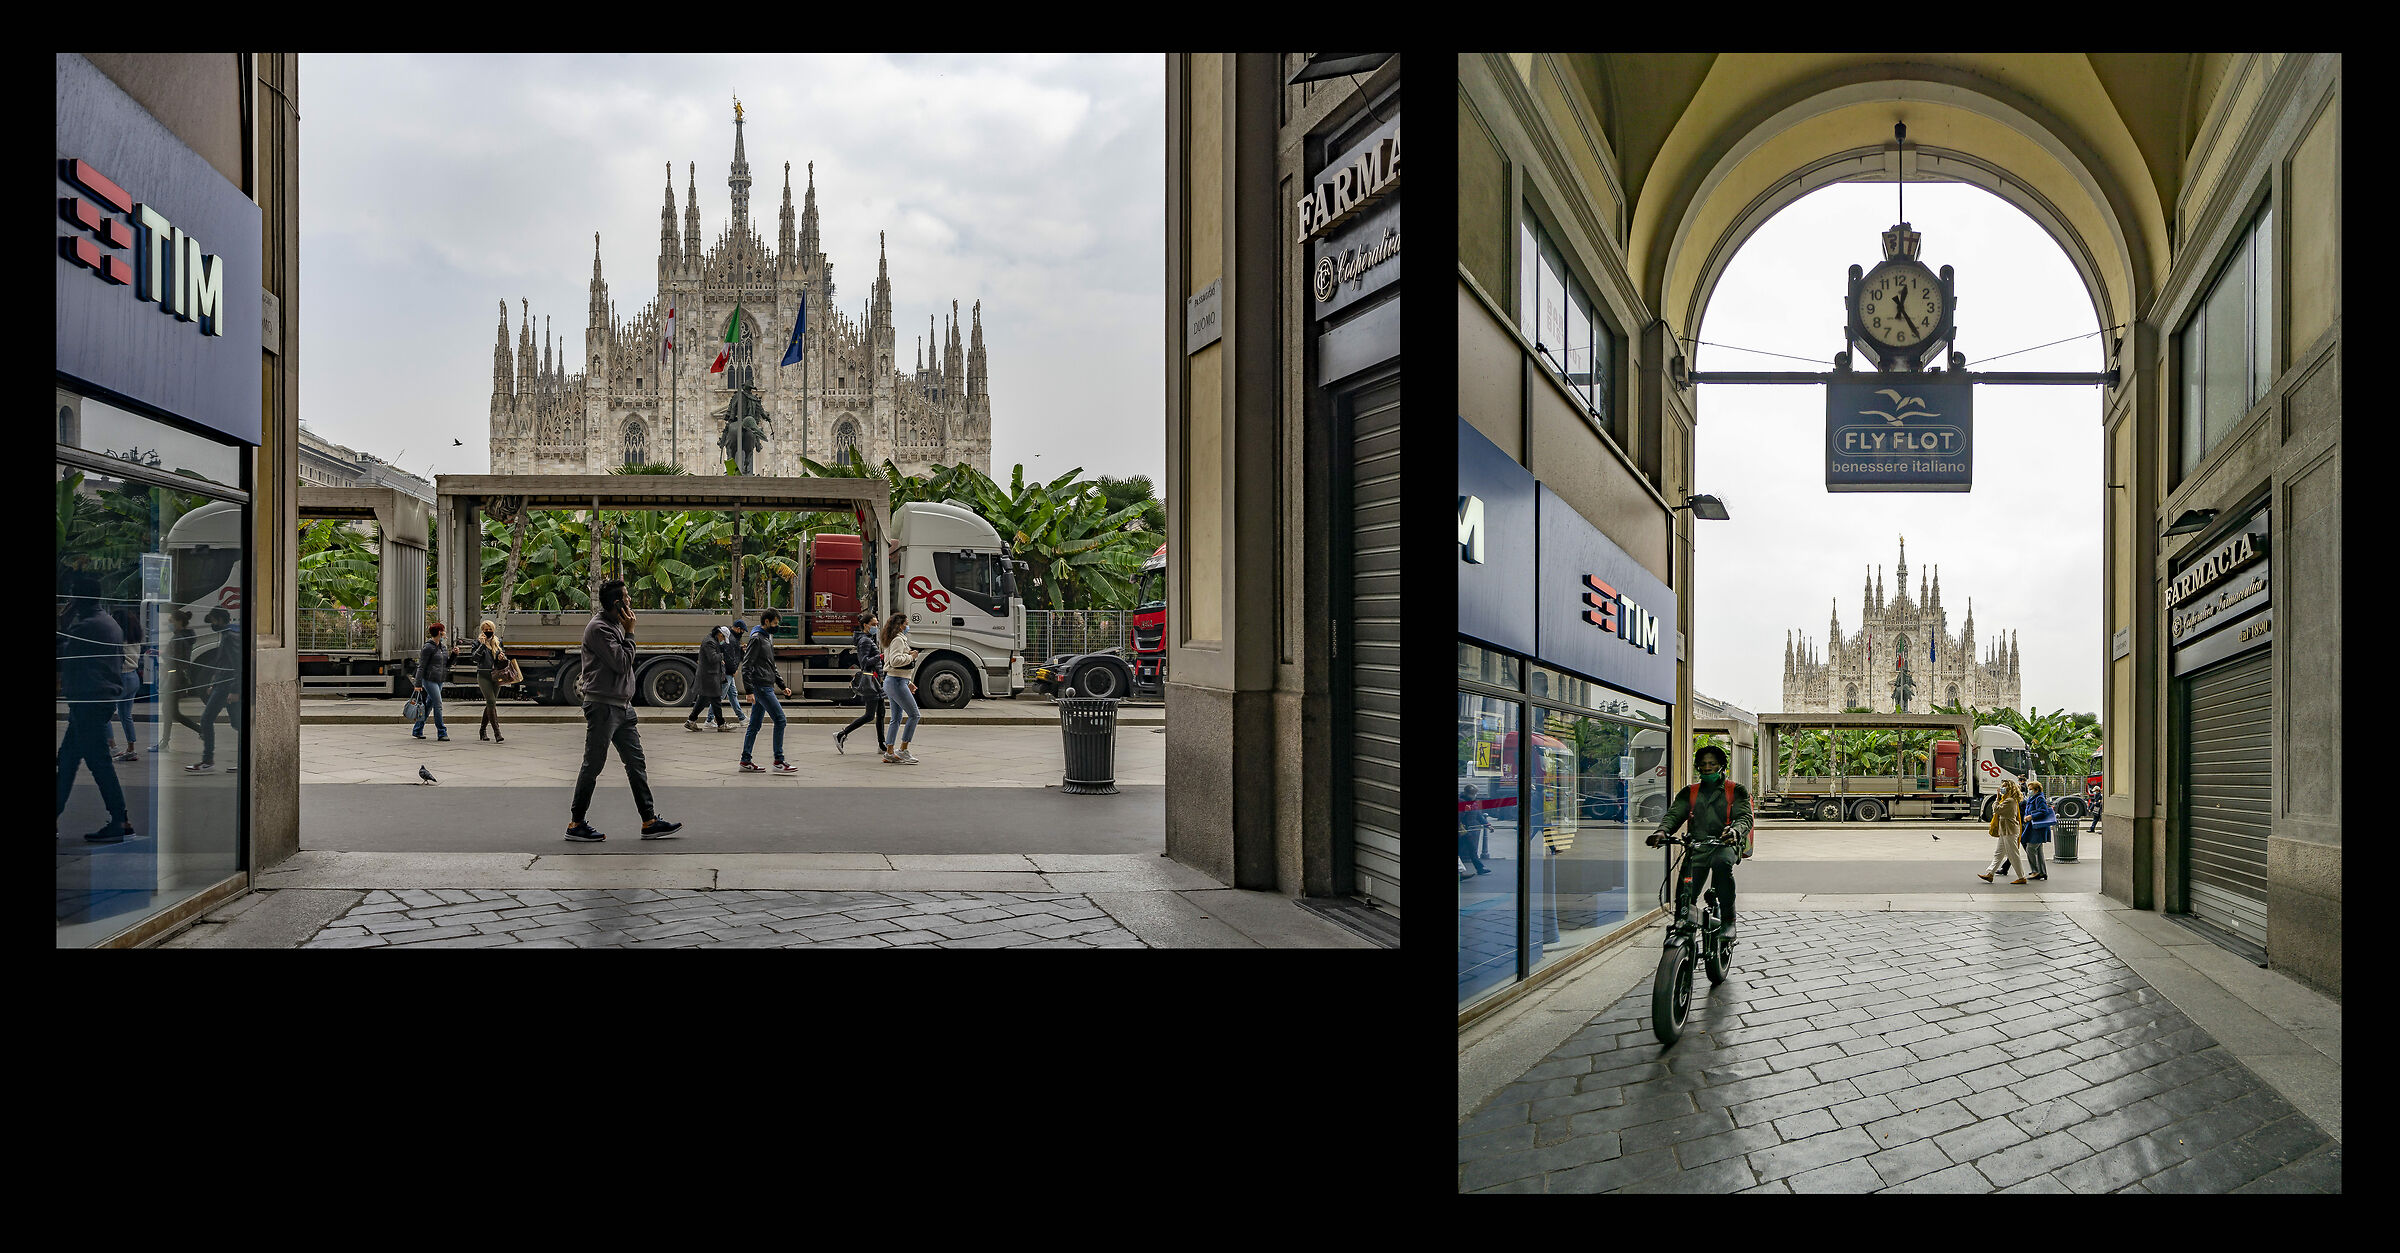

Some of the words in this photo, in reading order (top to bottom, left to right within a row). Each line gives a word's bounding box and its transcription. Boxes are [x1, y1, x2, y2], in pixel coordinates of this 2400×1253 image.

[1337, 227, 1400, 291] Cooperativa
[138, 203, 222, 336] TIM
[1881, 279, 1890, 290] 11
[1893, 275, 1906, 287] 12
[1911, 278, 1917, 289] 1
[1870, 289, 1882, 301] 10
[1922, 288, 1930, 299] 2
[1866, 303, 1875, 315] 9
[1926, 302, 1935, 313] 3
[1193, 311, 1216, 335] DUOMO
[1872, 317, 1881, 328] 8
[1921, 316, 1930, 328] 4
[1884, 327, 1892, 339] 7
[1896, 331, 1905, 342] 6
[1845, 432, 1886, 449] FLY
[1893, 432, 1954, 449] FLOT
[1832, 460, 1908, 472] benessere
[1912, 460, 1966, 472] italiano
[2165, 533, 2254, 611] FARMACIA
[1618, 594, 1659, 655] TIM
[2250, 619, 2268, 638] 1890
